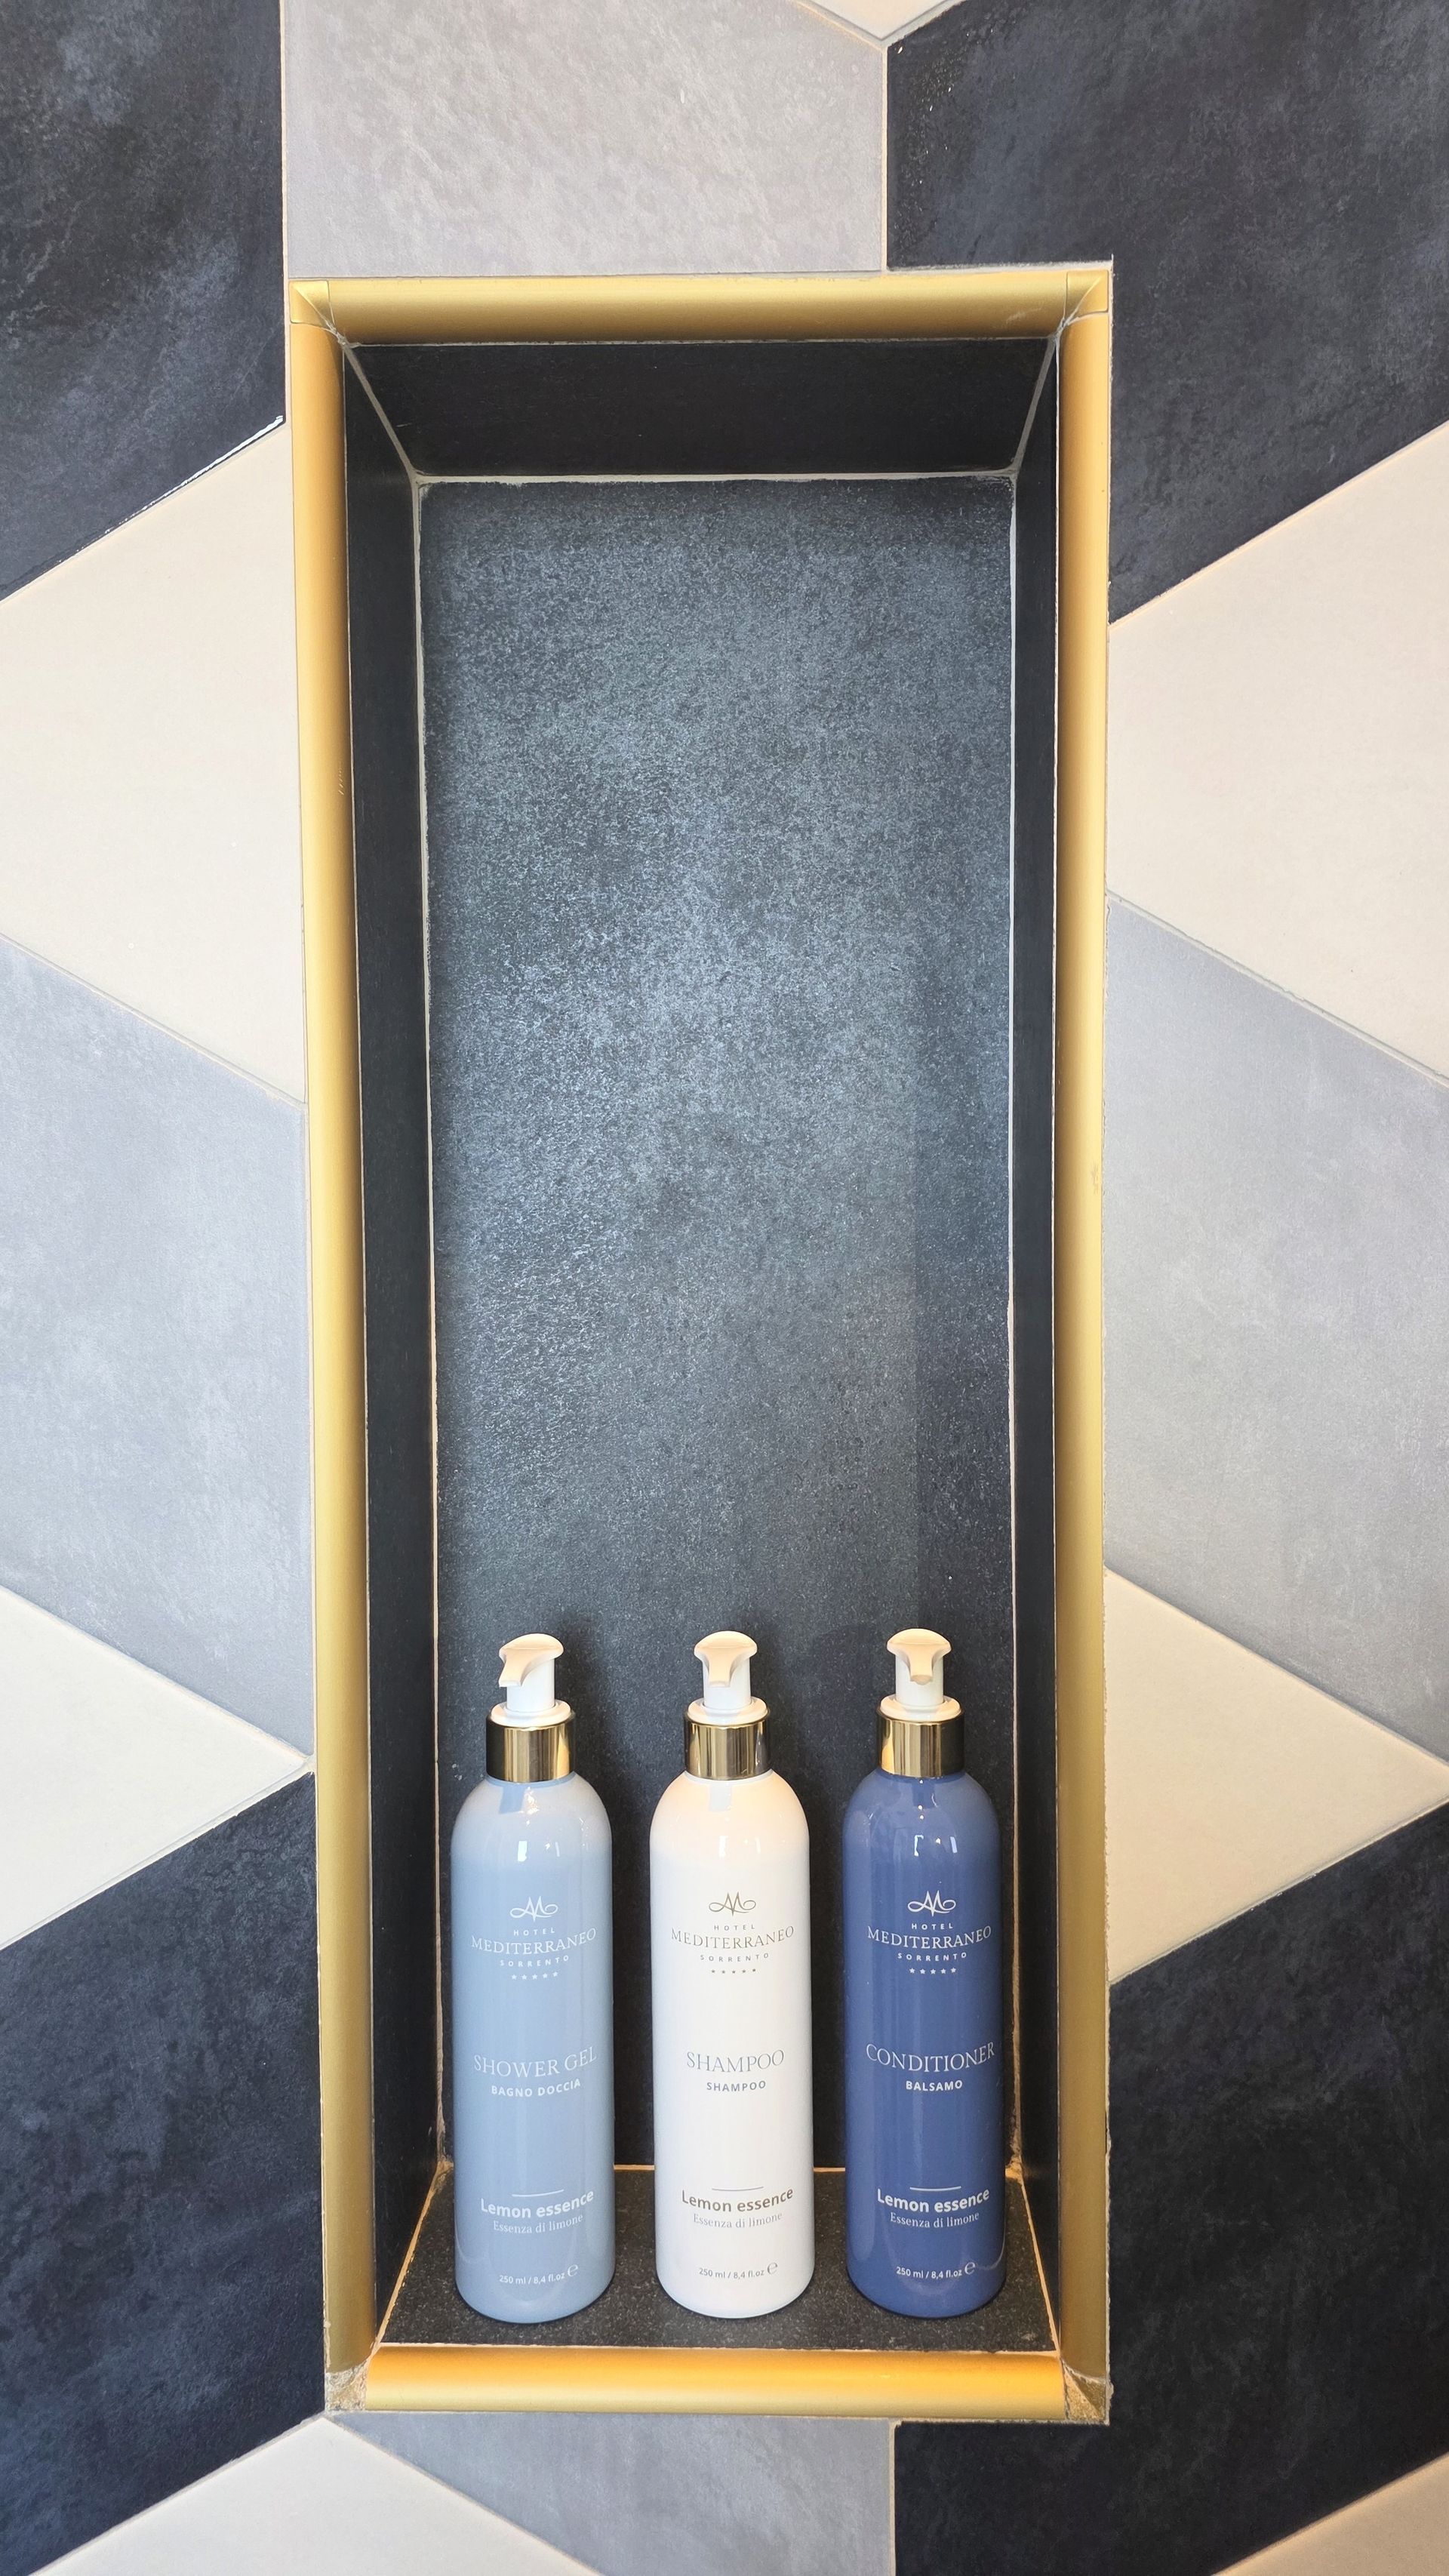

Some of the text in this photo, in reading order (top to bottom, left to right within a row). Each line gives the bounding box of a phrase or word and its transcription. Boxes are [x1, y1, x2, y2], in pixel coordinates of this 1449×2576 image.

[513, 1927, 555, 1936] HOTEL
[672, 1925, 794, 1949] MEDITERRANEO
[868, 1925, 992, 1949] MEDITERRANEO
[471, 1928, 597, 1955] MEDITERRANEO
[500, 1955, 569, 1967] SORRENTO
[700, 1953, 769, 1962] SORRENTO
[897, 1952, 967, 1962] SORRENTO
[474, 2046, 597, 2078] SHOWER GEL
[687, 2049, 784, 2073] SHAMPOO
[866, 2042, 995, 2073] CONDITIONER
[491, 2079, 581, 2097] BAGNO DOCCIA
[706, 2080, 766, 2091] SHAMPOO
[906, 2079, 963, 2091] BALSAMO
[481, 2191, 594, 2218] Lemon essence
[682, 2188, 793, 2212] Lemon essence
[877, 2188, 989, 2213] Lemon essence
[493, 2214, 583, 2233] Essenza di limone
[694, 2212, 783, 2228] Essenza di limone
[890, 2211, 980, 2228] Essenza di limone
[500, 2275, 513, 2284] 250
[515, 2276, 526, 2284] ml
[534, 2276, 546, 2285] 8,4
[548, 2272, 565, 2282] fl.oz
[699, 2267, 712, 2277] 250
[715, 2270, 725, 2279] ml
[733, 2270, 745, 2279] 8,4
[748, 2269, 764, 2278] fl.oz
[897, 2267, 911, 2276] 250
[912, 2270, 923, 2279] ml
[931, 2270, 943, 2279] 8,4
[946, 2269, 962, 2278] fl.oz
